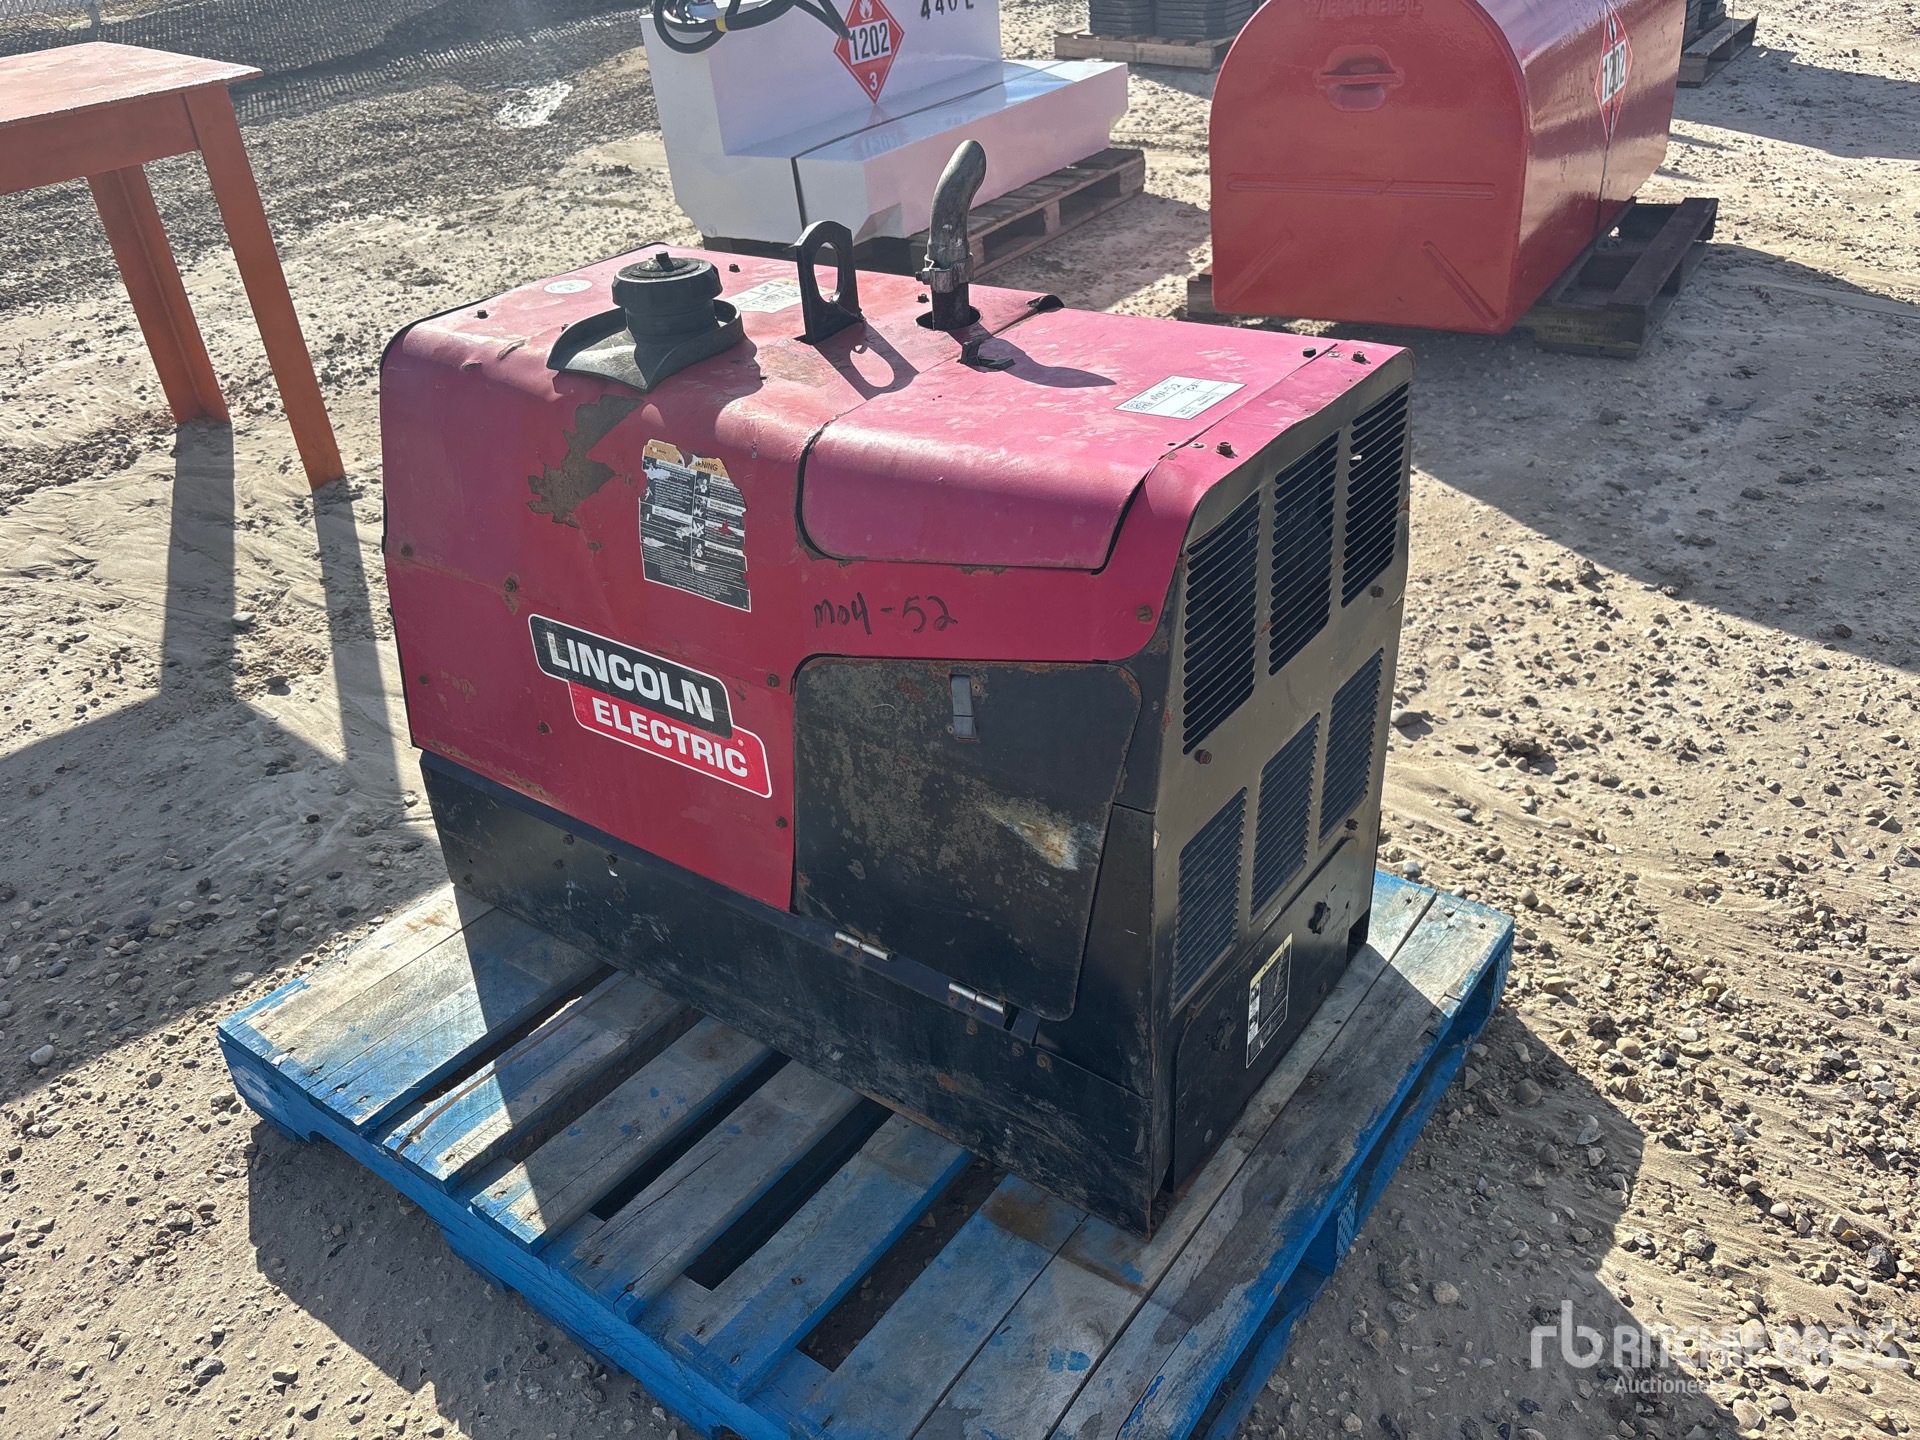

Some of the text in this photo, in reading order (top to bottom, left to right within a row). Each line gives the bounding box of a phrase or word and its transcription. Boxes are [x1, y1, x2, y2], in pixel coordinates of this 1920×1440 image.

[849, 22, 890, 61] 1202
[869, 71, 878, 91] 3
[546, 631, 715, 722] LINCOLN
[592, 696, 748, 777] ELECTRIC
